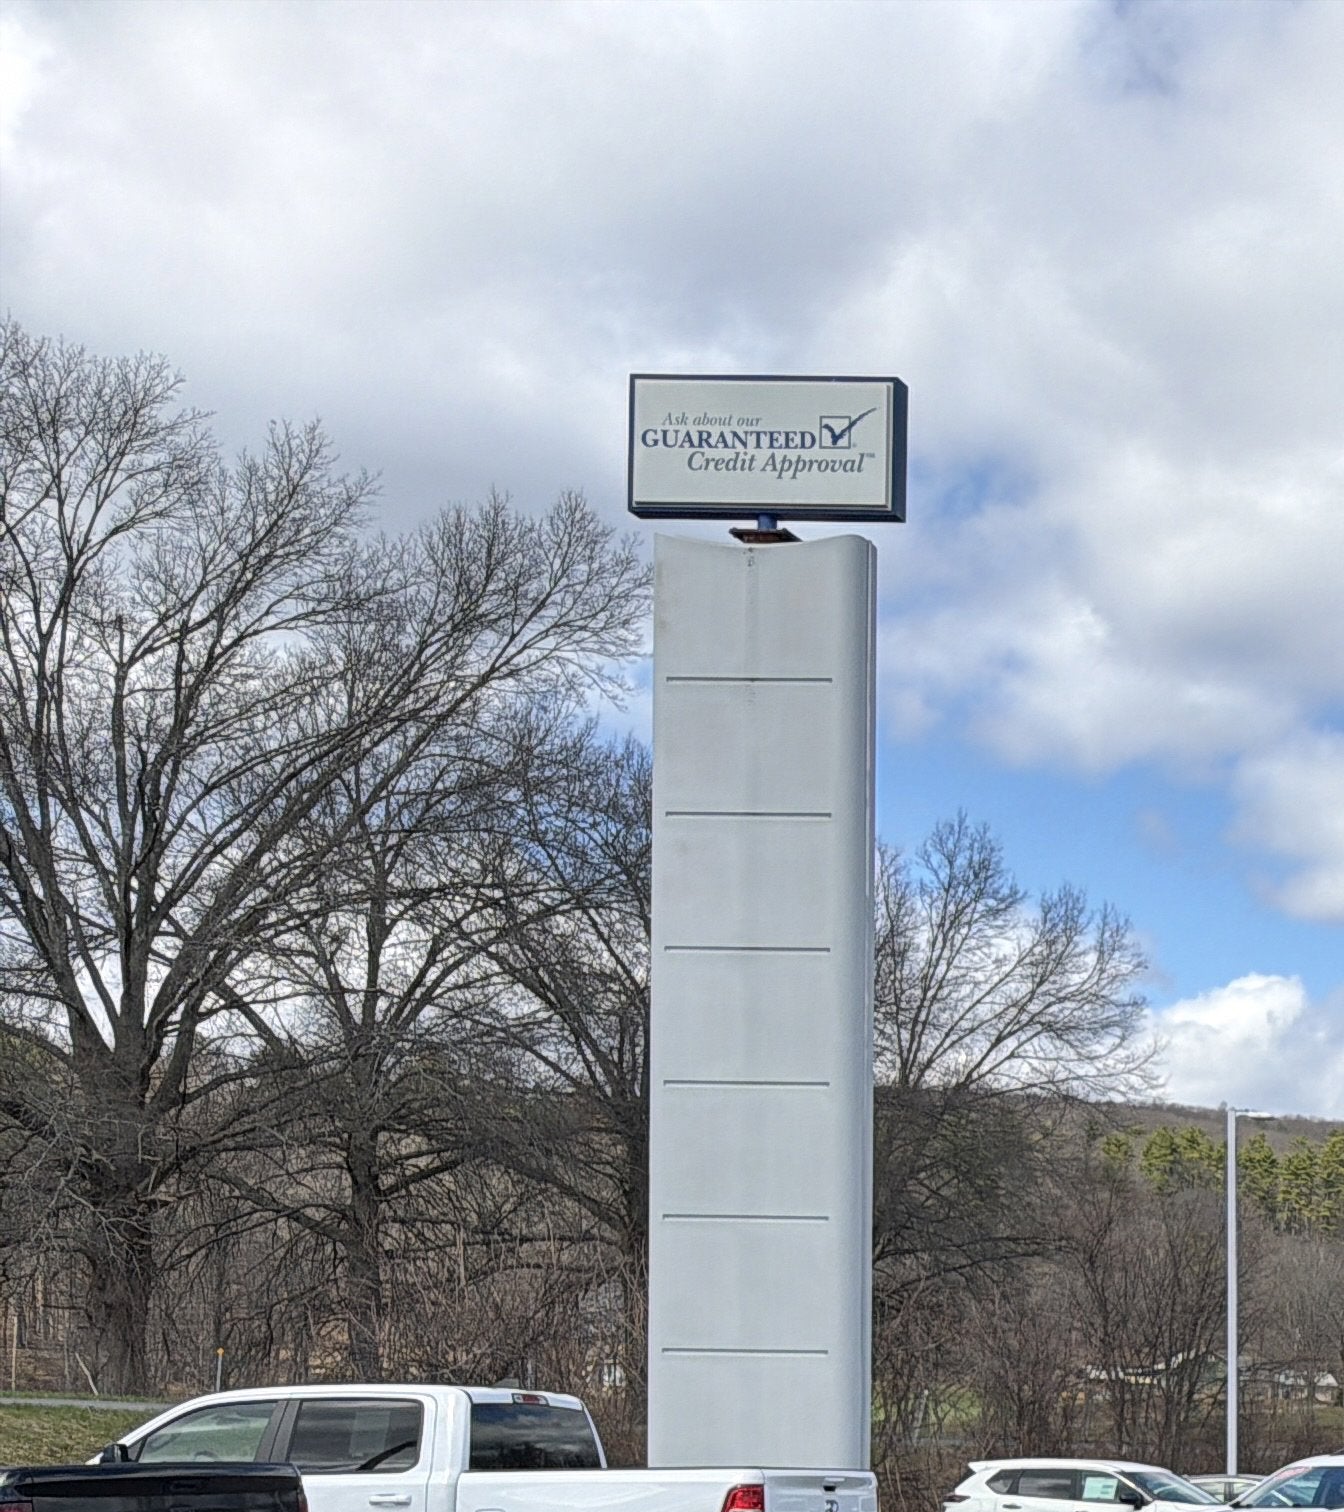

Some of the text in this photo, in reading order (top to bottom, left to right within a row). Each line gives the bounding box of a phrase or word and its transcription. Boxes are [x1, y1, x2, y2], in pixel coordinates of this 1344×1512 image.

[662, 412, 762, 427] Ask about our
[641, 429, 817, 450] GUARANTEED
[687, 451, 756, 472] Credit
